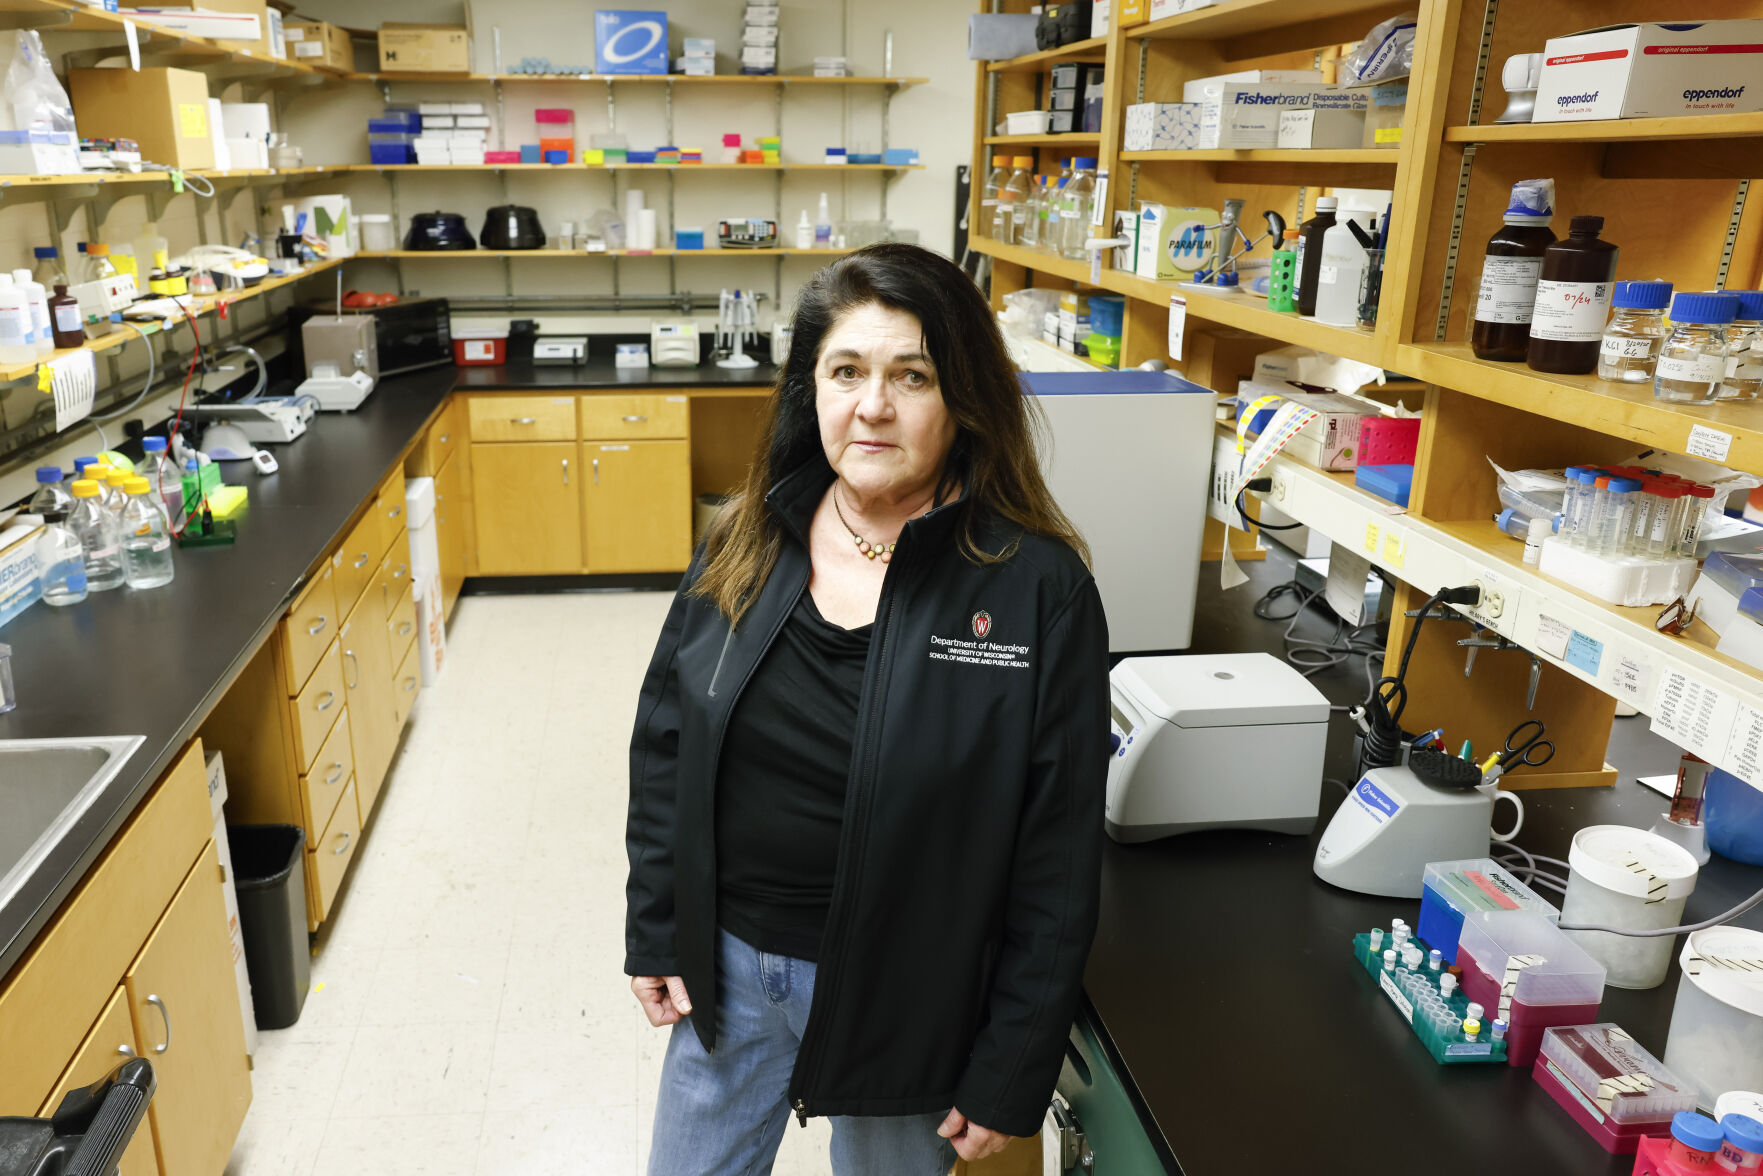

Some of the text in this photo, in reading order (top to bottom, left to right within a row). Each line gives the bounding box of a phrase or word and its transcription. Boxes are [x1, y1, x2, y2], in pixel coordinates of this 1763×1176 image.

[1235, 92, 1310, 105] Fisherbrand
[1313, 93, 1349, 102] Disposable
[1557, 90, 1599, 107] eppendorf
[1683, 85, 1745, 102] eppendorf
[1169, 240, 1212, 249] PARAFILM
[976, 620, 988, 634] W
[930, 635, 1029, 655] Department of Neurology
[929, 652, 949, 660] SCHOOL
[956, 655, 980, 664] MEDICINE
[947, 648, 976, 656] UNIVERSITY
